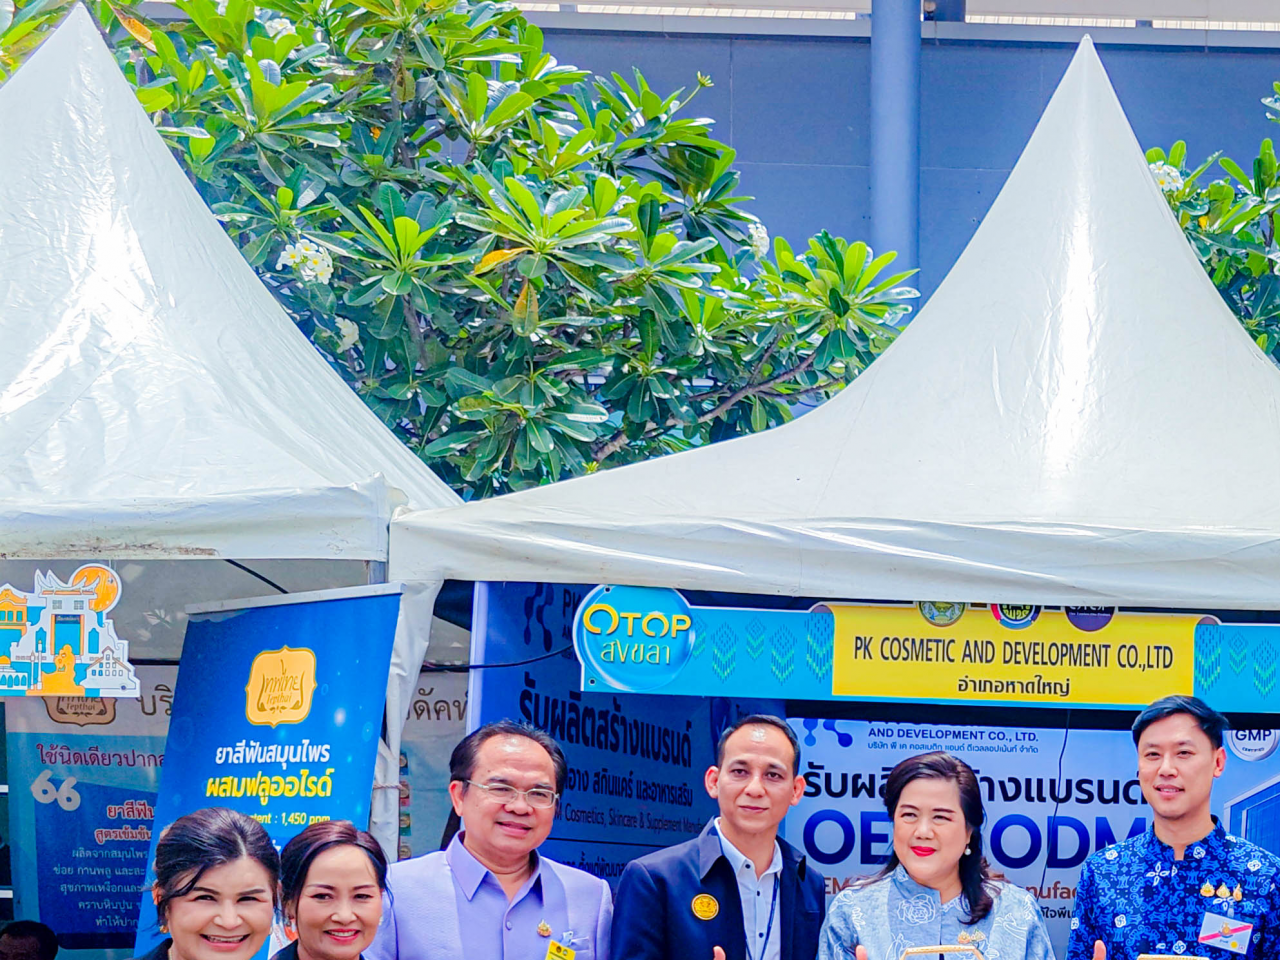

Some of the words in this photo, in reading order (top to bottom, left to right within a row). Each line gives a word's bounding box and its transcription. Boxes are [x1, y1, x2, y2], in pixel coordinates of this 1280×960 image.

[583, 603, 691, 637] OTOP
[854, 636, 873, 660] PK
[880, 637, 956, 662] COSMETIC
[962, 640, 995, 664] AND
[1003, 641, 1111, 667] DEVELOPMENT
[1117, 645, 1173, 672] CO.,LTD
[958, 674, 1070, 697] อำเภอหาดใหญ่
[136, 684, 173, 716] บริ
[868, 727, 894, 738] AND
[897, 728, 985, 740] DEVELOPMENT
[988, 731, 1012, 743] CO.,
[1015, 732, 1039, 742] LTD.
[1235, 729, 1272, 742] GMP
[215, 739, 330, 771] ยาสีฟันสมุนไพร
[206, 768, 335, 806] ผสมฟลูออไรด์
[281, 812, 307, 826] 1,450
[565, 803, 606, 827] Cosmetics,
